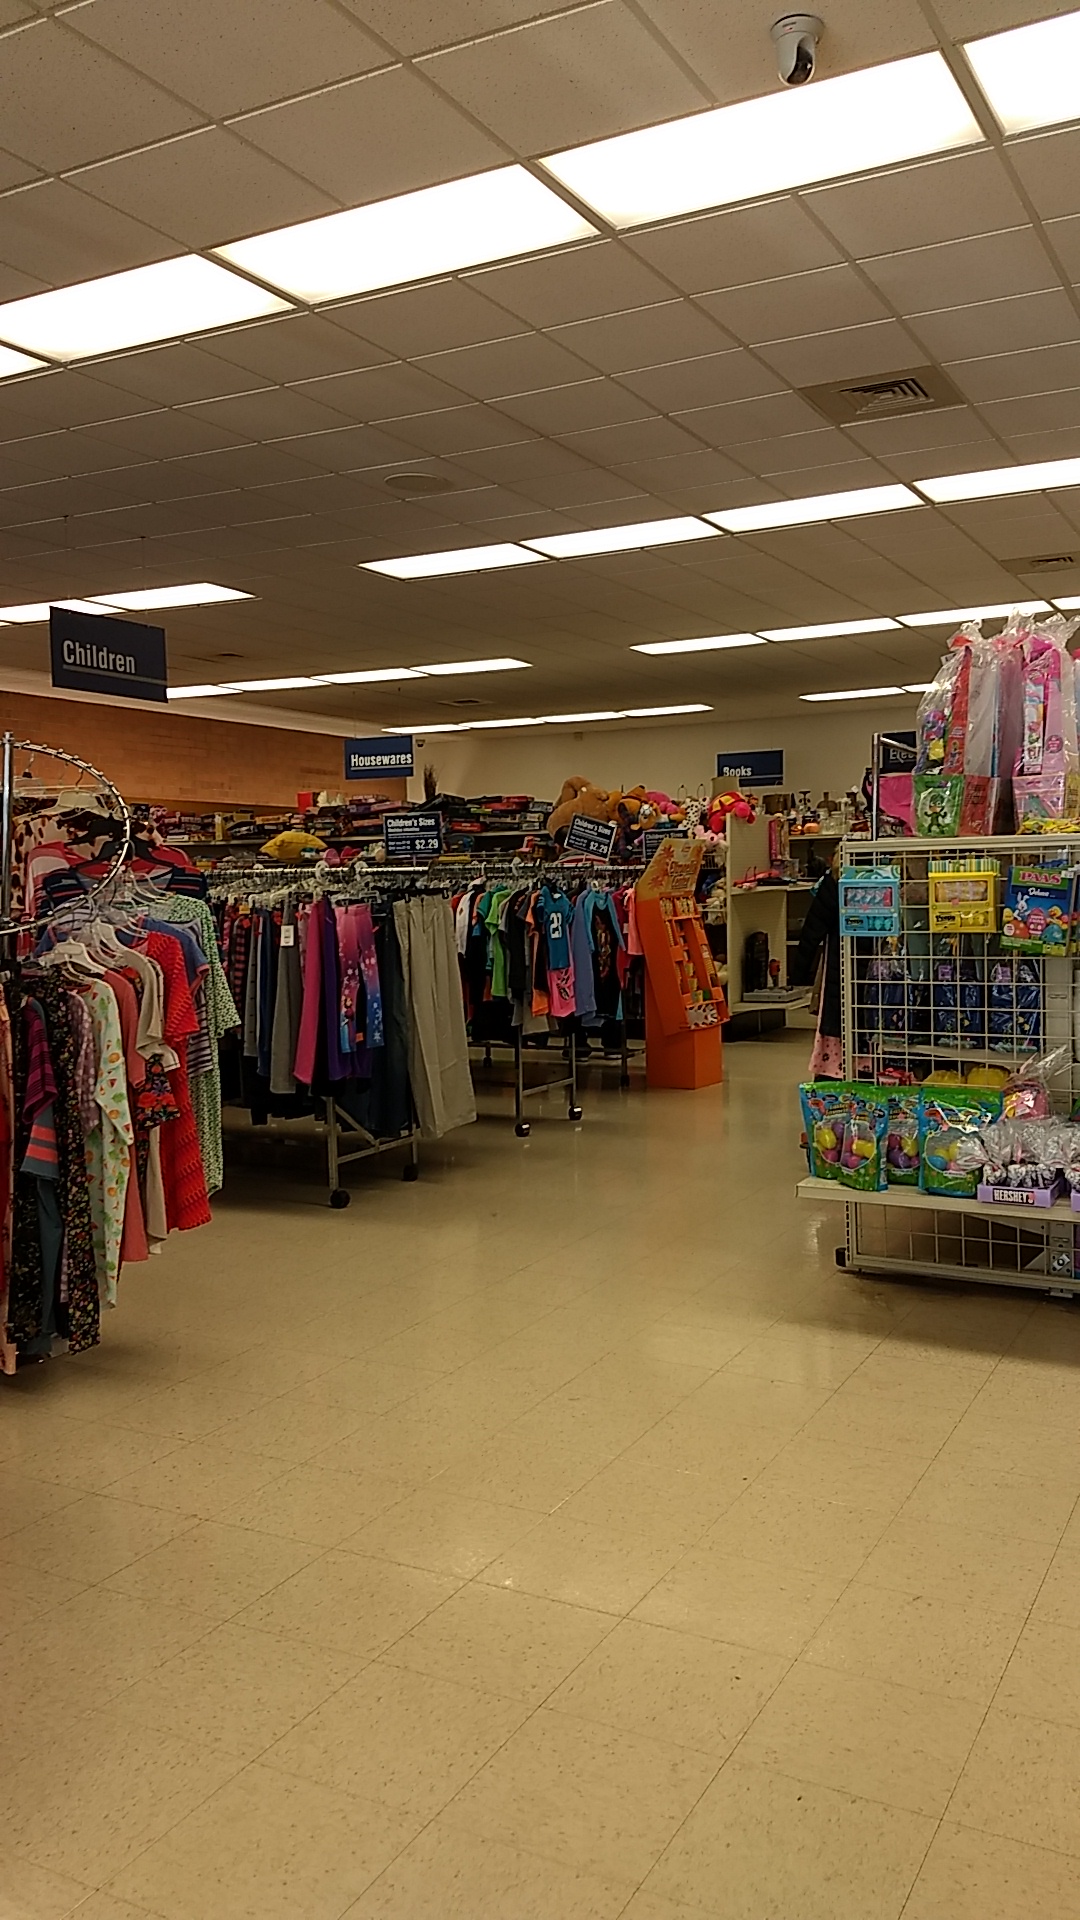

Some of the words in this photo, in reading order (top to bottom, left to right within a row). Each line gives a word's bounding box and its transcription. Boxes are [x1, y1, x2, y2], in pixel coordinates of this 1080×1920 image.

[63, 640, 136, 674] Children
[350, 754, 412, 767] Housewares
[723, 765, 752, 777] Books
[387, 818, 418, 827] Children's
[414, 838, 439, 850] $2.29
[589, 841, 608, 854] $2.29
[1019, 871, 1061, 885] PAAS
